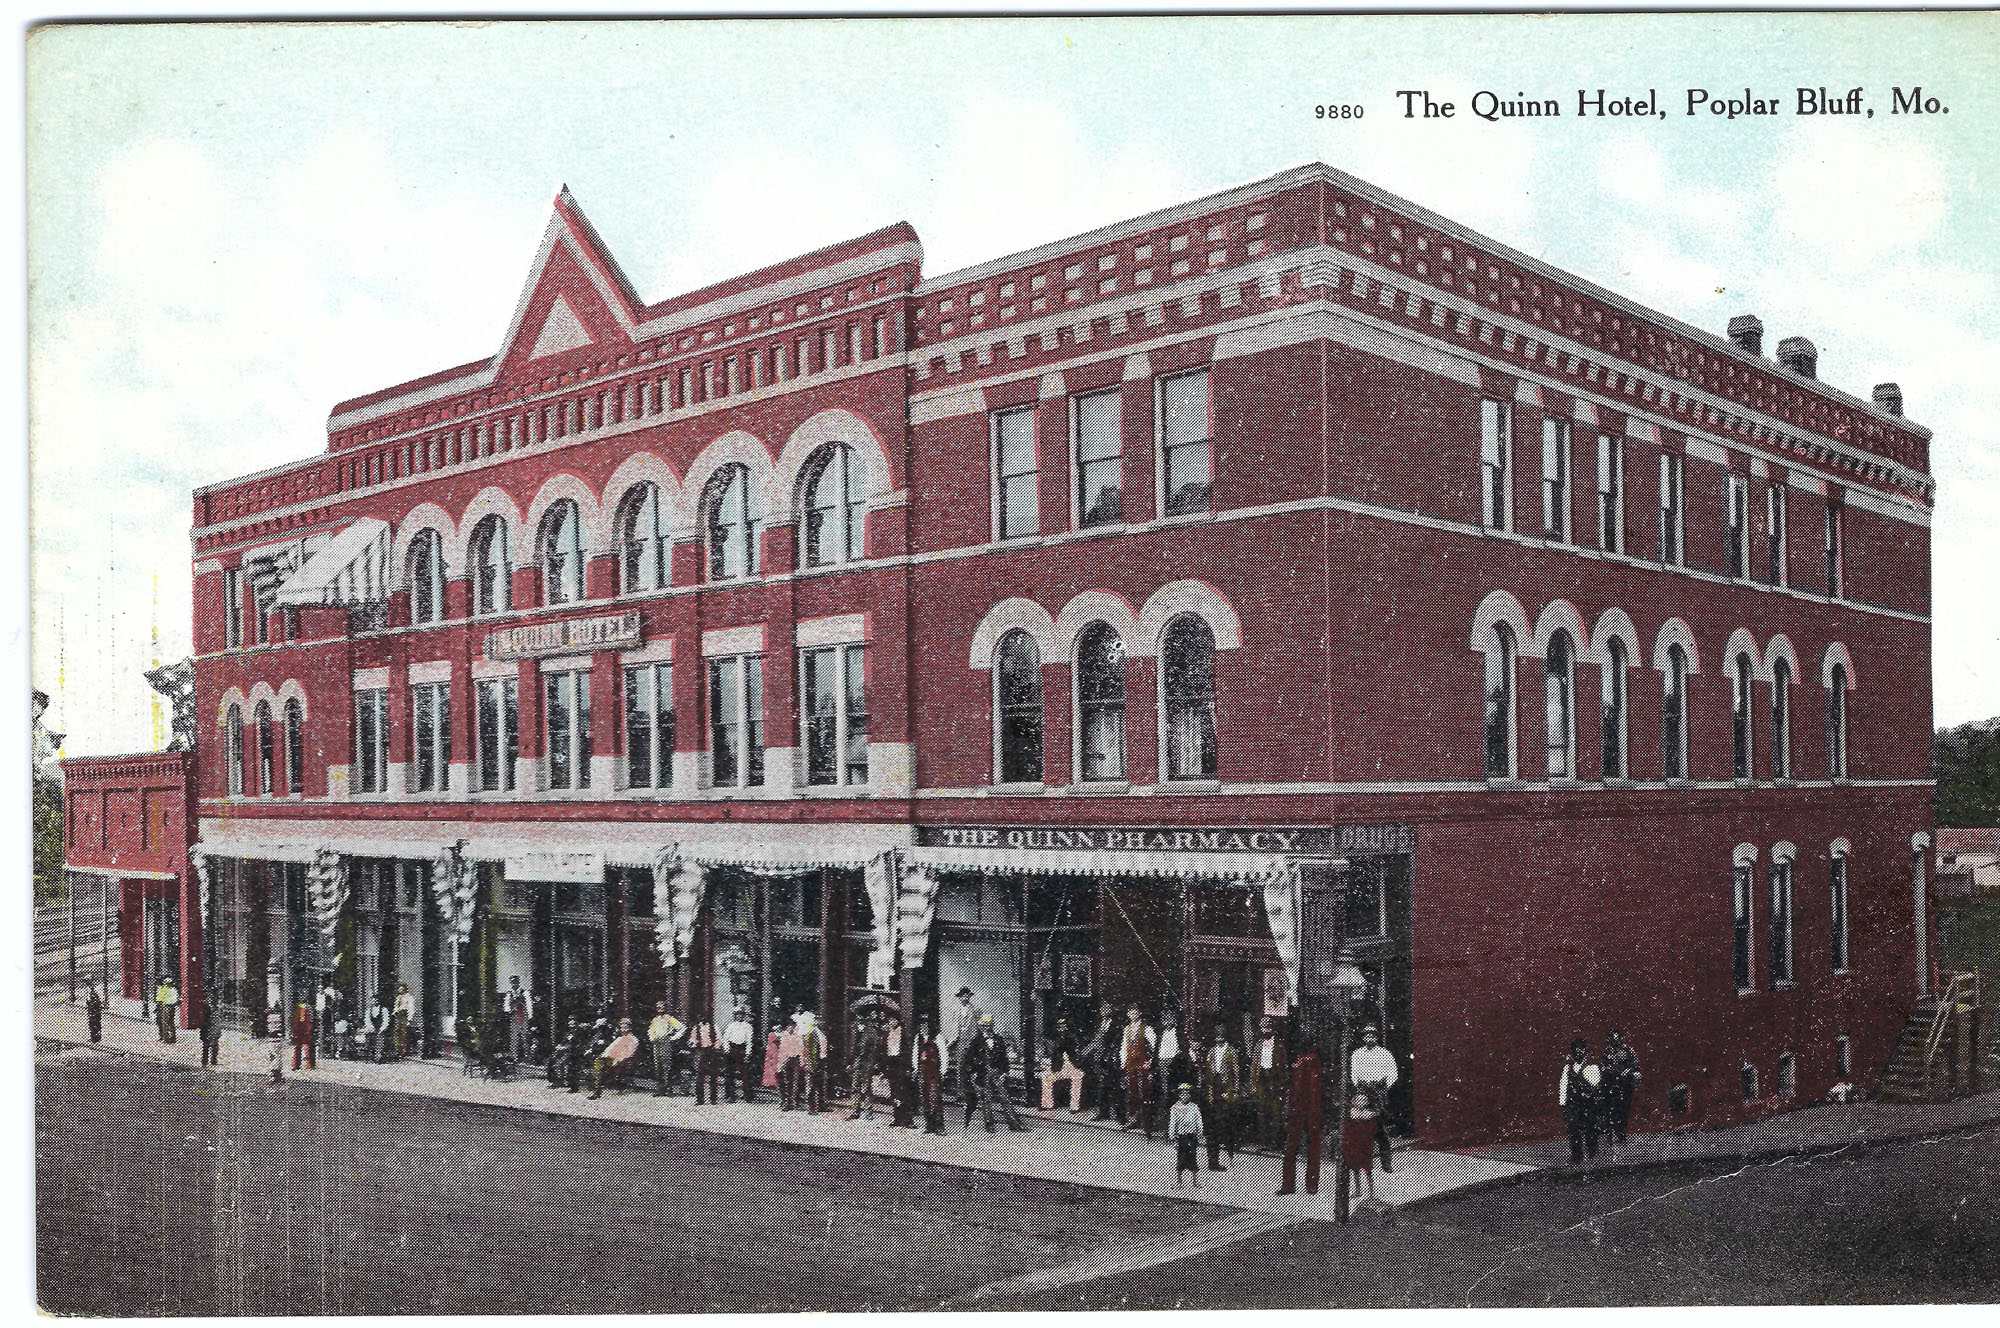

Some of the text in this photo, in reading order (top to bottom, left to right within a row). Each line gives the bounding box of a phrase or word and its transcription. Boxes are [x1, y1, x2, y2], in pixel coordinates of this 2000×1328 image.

[568, 614, 626, 645] HOTEL
[943, 828, 1000, 848] THE
[1007, 829, 1096, 850] QUINN
[1341, 824, 1409, 849] DRUGS
